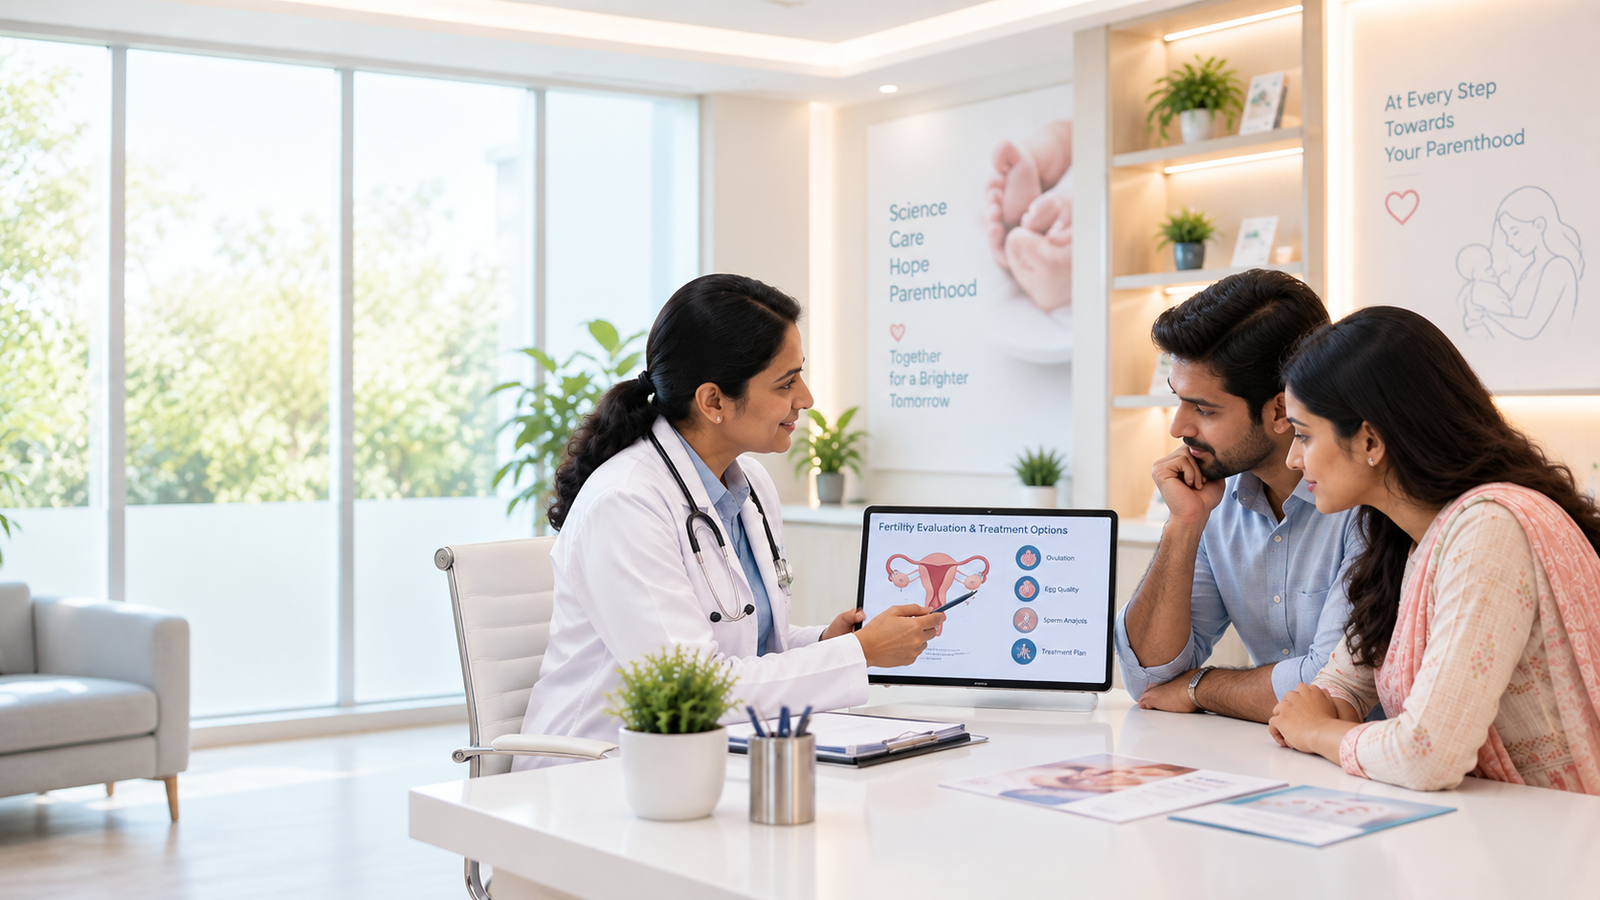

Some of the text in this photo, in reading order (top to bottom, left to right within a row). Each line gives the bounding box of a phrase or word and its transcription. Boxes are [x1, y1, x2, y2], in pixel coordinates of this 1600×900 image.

[1385, 81, 1497, 112] At Every Step
[1385, 112, 1455, 137] Towards
[1385, 127, 1525, 163] Your Parenthood
[889, 201, 948, 222] Science
[889, 230, 924, 249] Care
[889, 258, 930, 277] Hope
[889, 278, 977, 302] Parenthood
[889, 349, 942, 367] Together
[889, 371, 969, 388] for a Brighter
[889, 393, 950, 408] Tomorrow
[878, 522, 1068, 536] Fertility Evaluation & Treatment Options
[1044, 586, 1080, 594] Egg Quality
[1043, 617, 1063, 625] Sperm
[1042, 648, 1072, 656] Treatment
